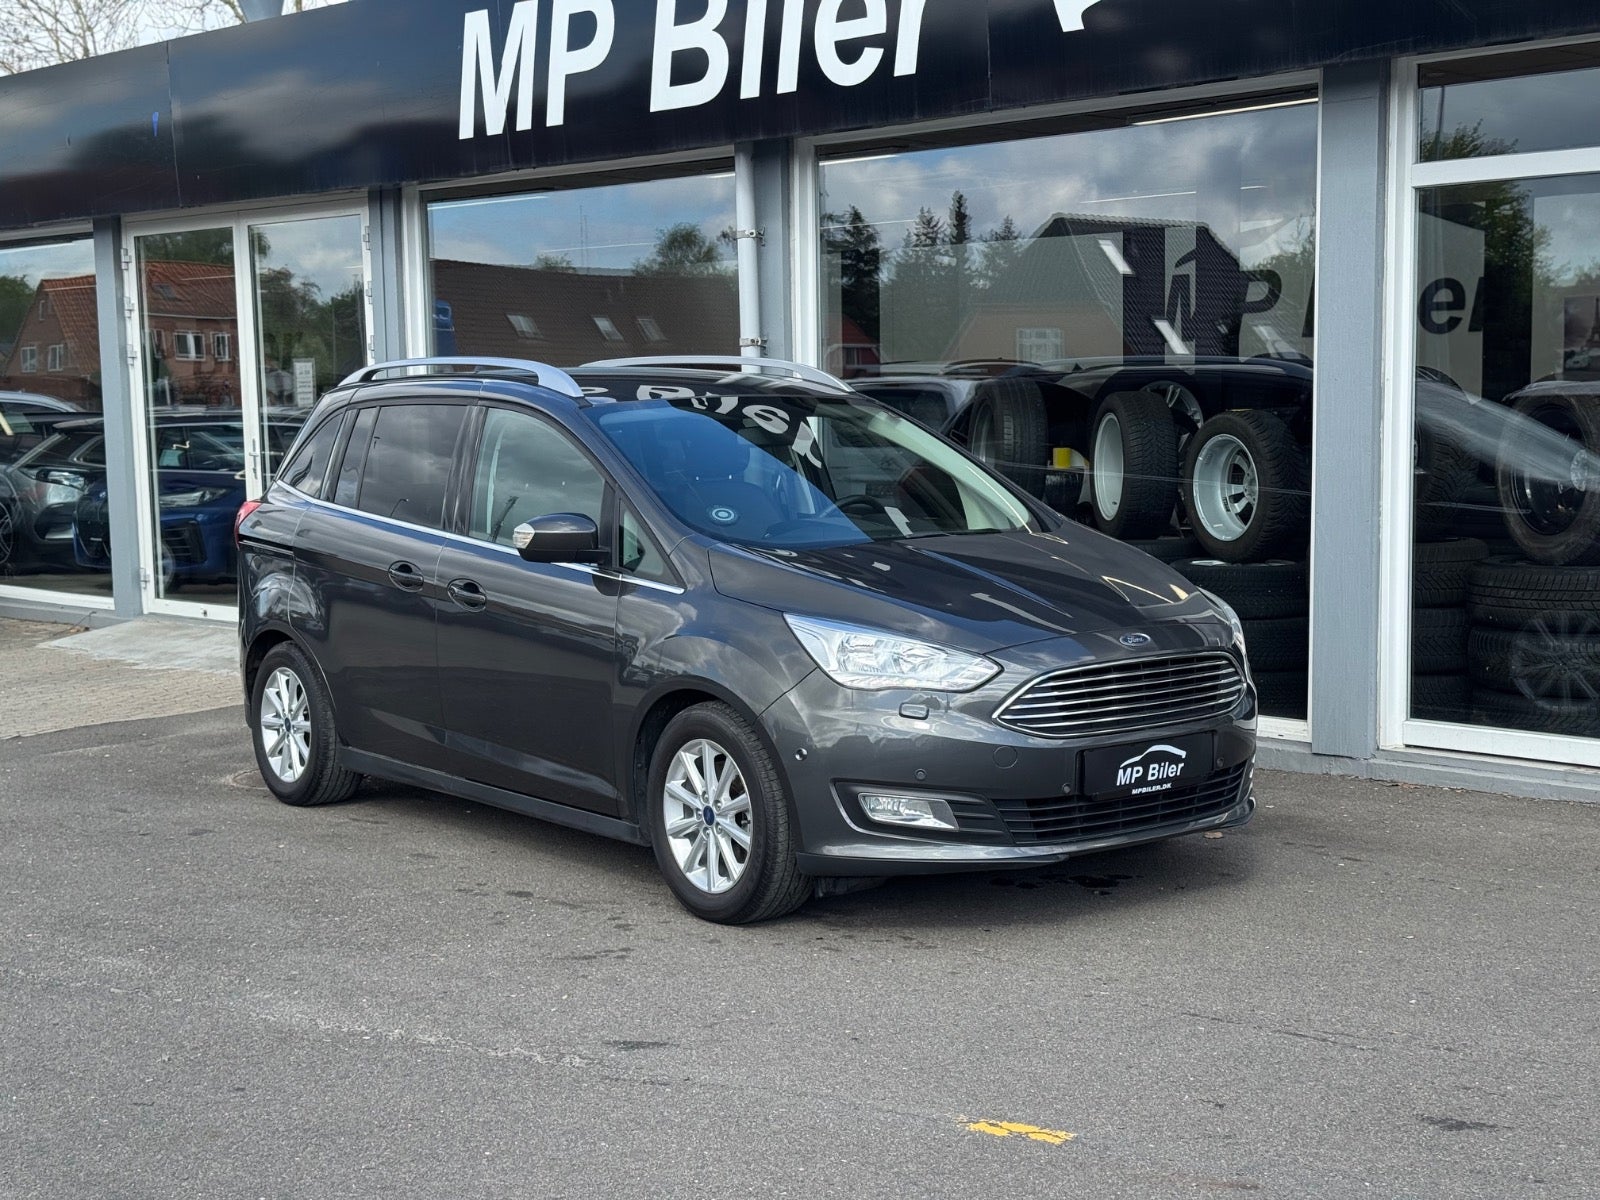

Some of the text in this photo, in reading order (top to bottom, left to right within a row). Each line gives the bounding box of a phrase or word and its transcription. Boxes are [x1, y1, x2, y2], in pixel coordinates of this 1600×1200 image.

[459, 0, 615, 140] MP
[1117, 761, 1185, 786] MP Biler
[1131, 782, 1172, 795] MPBILER.DK
